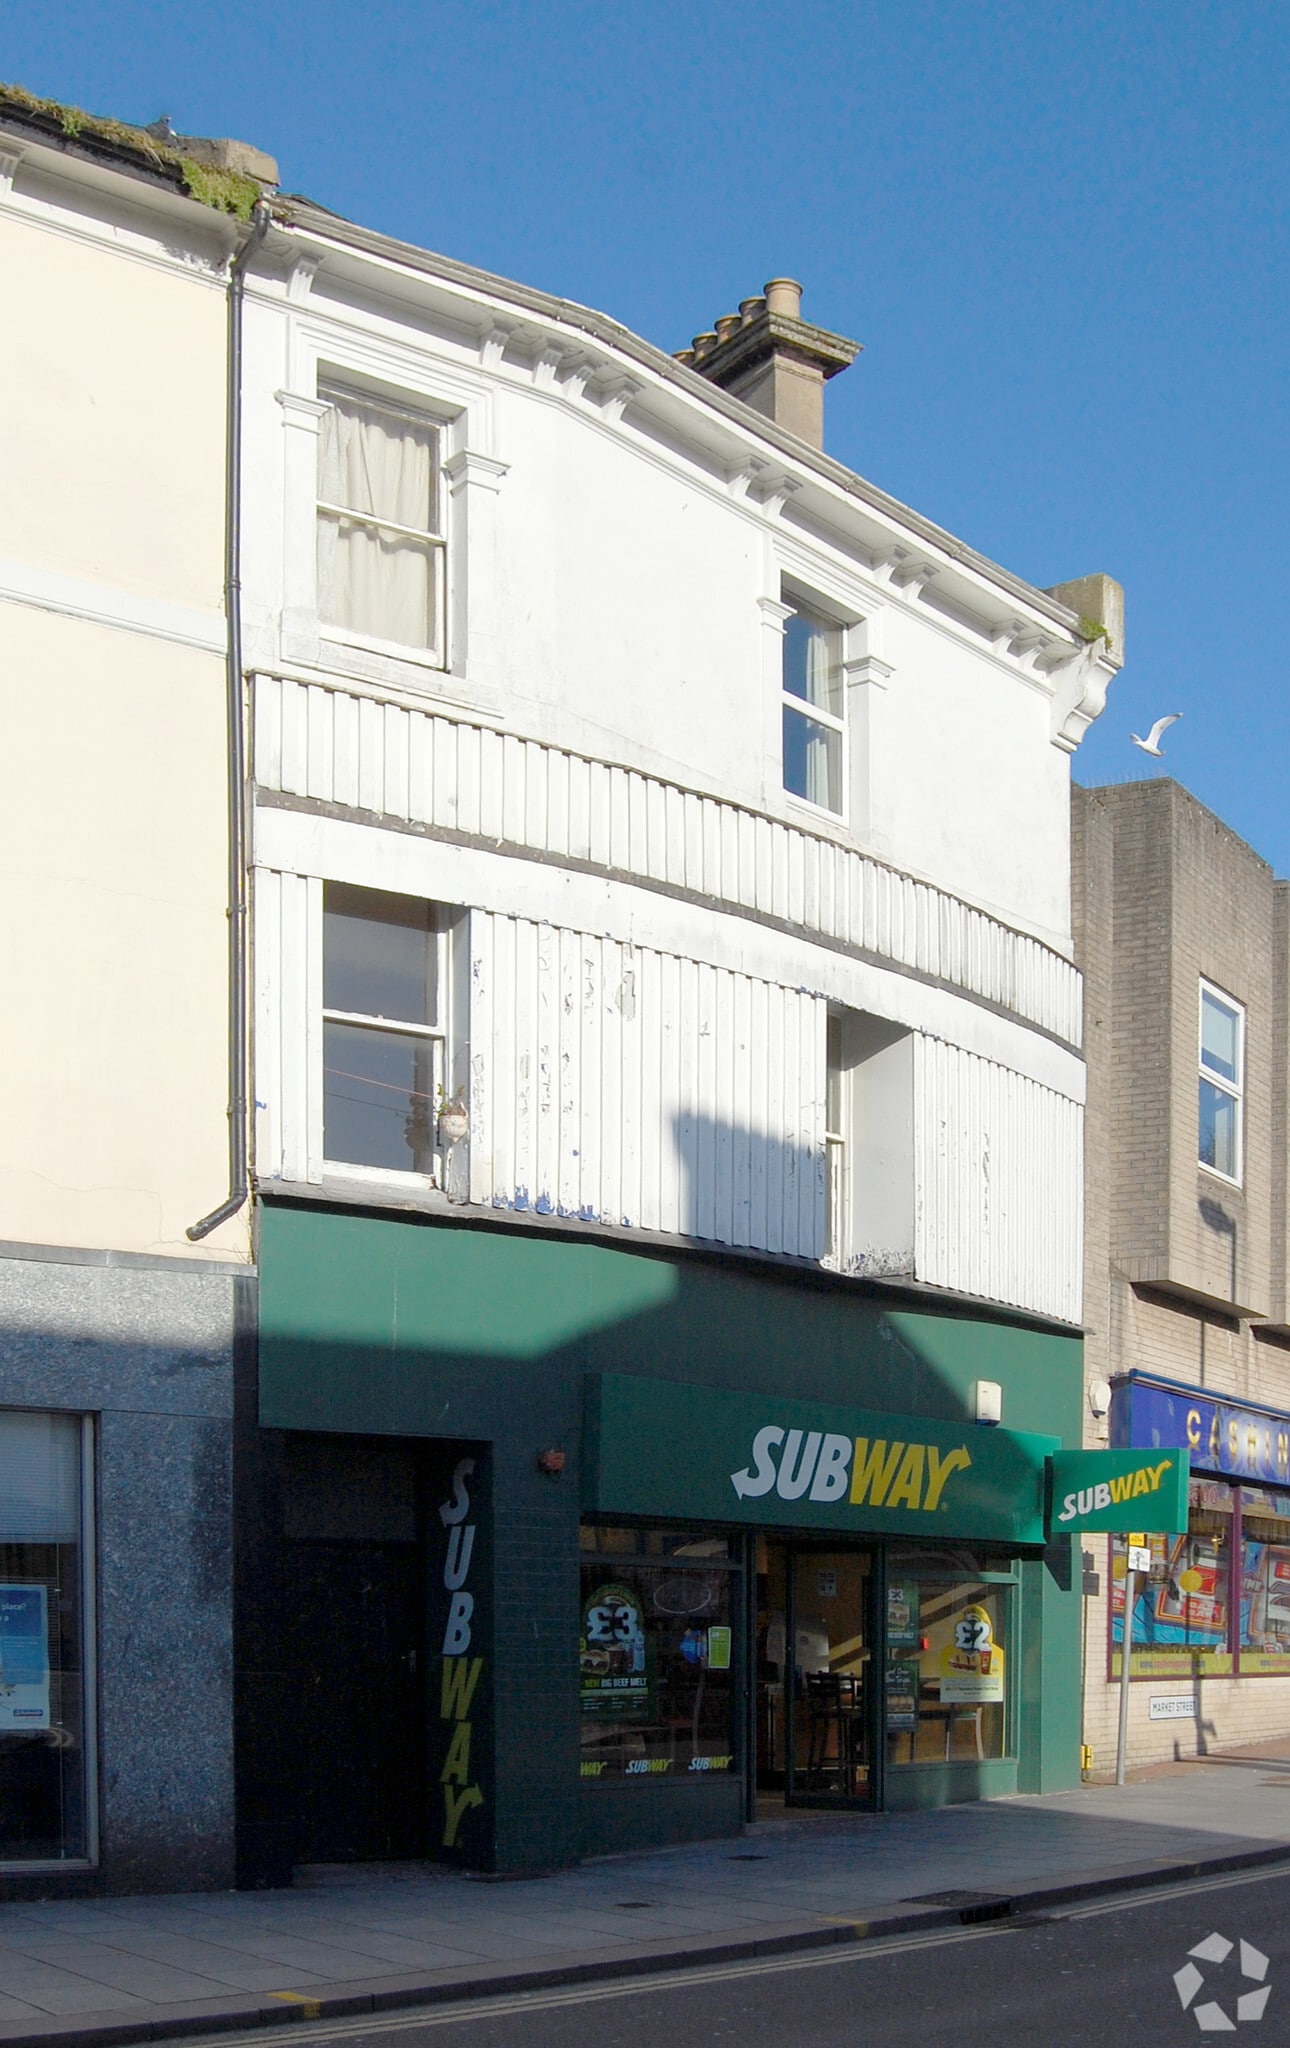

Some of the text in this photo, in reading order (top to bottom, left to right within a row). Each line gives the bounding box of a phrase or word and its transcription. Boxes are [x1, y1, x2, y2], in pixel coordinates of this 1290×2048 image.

[730, 1425, 973, 1512] SUBWAY
[1058, 1459, 1173, 1522] SUBWAY
[586, 1605, 638, 1643] £3
[955, 1619, 992, 1651] £2
[439, 1457, 484, 1847] SUBWAY
[601, 1678, 613, 1688] BIG
[613, 1677, 630, 1688] BEEF
[630, 1677, 648, 1687] MELT
[1152, 1702, 1175, 1712] MARKET
[625, 1758, 673, 1774] SUBWAY
[688, 1755, 733, 1771] SUBWAY
